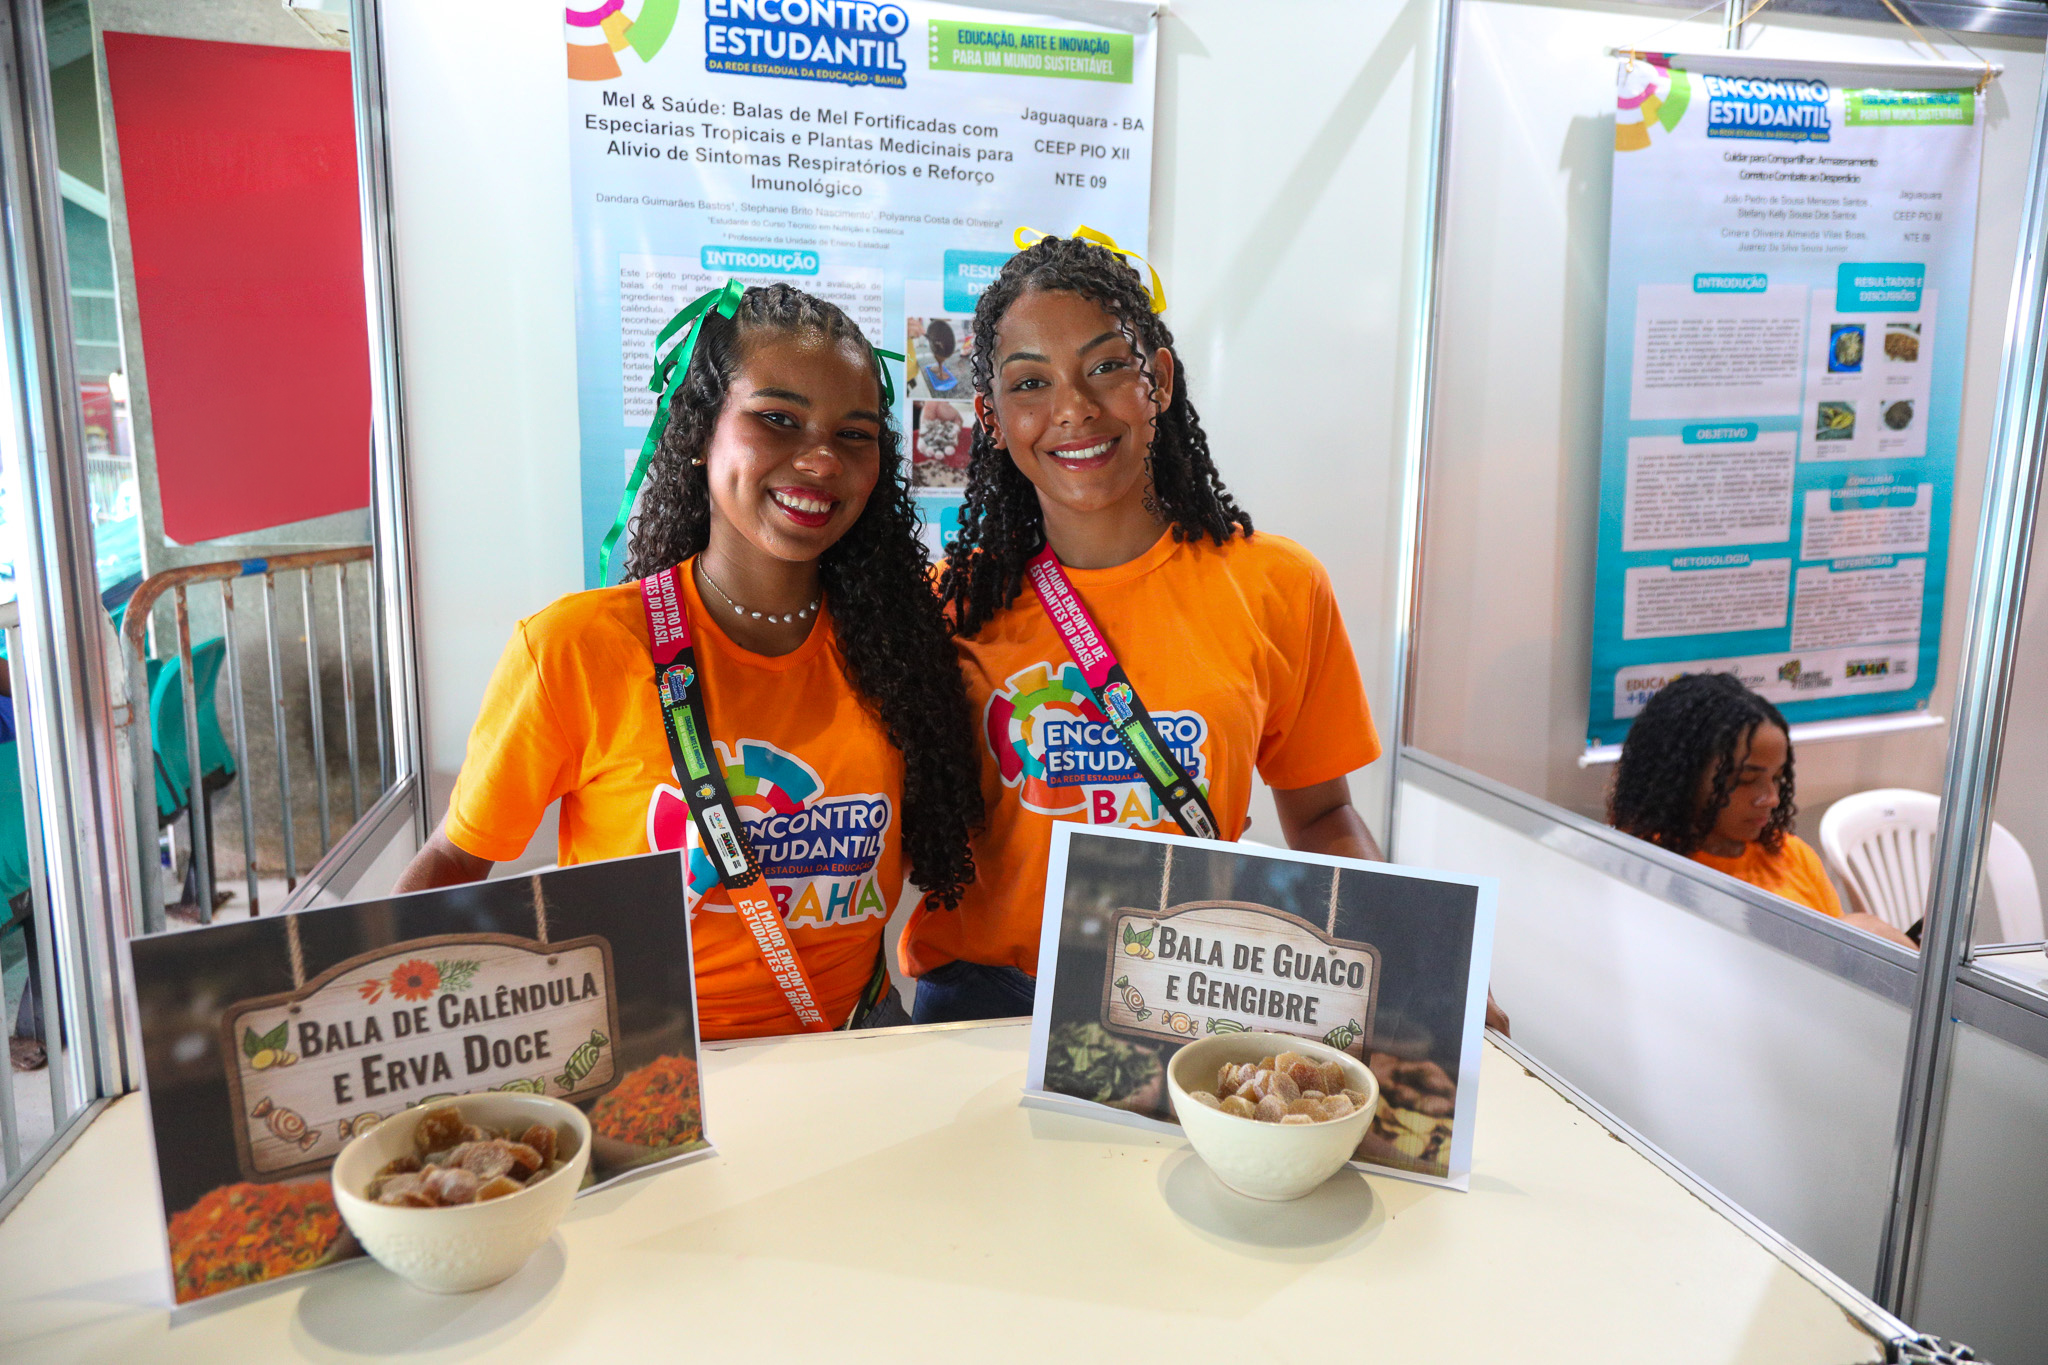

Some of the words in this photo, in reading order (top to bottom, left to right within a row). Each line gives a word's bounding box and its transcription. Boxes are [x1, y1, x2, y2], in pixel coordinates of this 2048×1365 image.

[708, 0, 907, 35] ENCONTRO
[708, 24, 904, 70] ESTUDANTIL
[958, 29, 1018, 49] EDUCAÇÃO,
[1020, 34, 1047, 50] ARTE
[1050, 36, 1057, 50] E
[1059, 36, 1109, 55] INOVAÇÃO
[709, 59, 724, 70] DA
[725, 61, 751, 73] REDE
[752, 63, 799, 77] ESTADUAL
[801, 67, 815, 78] DA
[816, 68, 868, 83] EDUCAÇÃO
[875, 74, 904, 86] BAHIA
[953, 49, 982, 65] PARA
[984, 51, 1001, 66] UM
[1003, 52, 1042, 69] MUNDO
[1044, 54, 1114, 75] SUSTENTÁVEL
[1704, 76, 1829, 102] ENCONTRO
[602, 91, 635, 108] Mel
[642, 95, 655, 110] &
[662, 97, 726, 115] Saúde:
[733, 101, 783, 120] Balas
[790, 107, 811, 122] de
[818, 108, 848, 125] Mel
[854, 111, 957, 135] Fortificadas
[962, 124, 998, 138] com
[1021, 107, 1108, 128] Jaguaquara
[1122, 117, 1144, 131] BA
[1709, 100, 1830, 128] ESTUDANTIL
[585, 114, 695, 138] Especiarias
[701, 123, 785, 144] Tropicais
[791, 134, 801, 145] e
[808, 131, 873, 151] Plantas
[880, 137, 971, 159] Medicinais
[978, 149, 1013, 162] para
[1034, 139, 1076, 155] CEEP
[1080, 144, 1106, 159] PIO
[1111, 146, 1130, 160] XII
[607, 140, 661, 159] Alívio
[667, 146, 689, 161] de
[695, 147, 781, 167] Sintomas
[788, 153, 907, 176] Respiratórios
[912, 166, 922, 177] e
[928, 164, 994, 186] Reforço
[751, 174, 862, 198] Imunológico
[1055, 172, 1085, 187] NTE
[1090, 175, 1107, 189] 09
[596, 193, 639, 205] Dandara
[641, 195, 695, 209] Guimarães
[740, 202, 788, 216] Stephanie
[791, 205, 813, 216] Brito
[879, 211, 921, 224] Polyanna
[924, 213, 951, 225] Costa
[952, 216, 964, 226] de
[620, 268, 640, 278] Este
[646, 271, 677, 281] projeto
[706, 250, 816, 273] INTRODUÇÃO
[1697, 275, 1766, 290] INTRODUÇÃO
[1696, 427, 1748, 440] OBJETIVO
[1042, 560, 1053, 569] O
[1673, 553, 1750, 568] METODOLOGIA
[1030, 563, 1068, 622] ESTUDANTES
[1045, 566, 1069, 597] MAIOR
[648, 596, 663, 610] DO
[660, 576, 681, 626] ENCONTRO
[651, 611, 670, 647] BRASIL
[669, 626, 684, 641] DE
[1061, 594, 1099, 647] ENCONTRO
[1061, 620, 1076, 636] DO
[1068, 636, 1096, 672] BRASIL
[1090, 645, 1108, 662] DE
[1050, 776, 1062, 784] DA
[1063, 773, 1085, 783] REDE
[1087, 772, 1132, 782] ESTADUAL
[748, 803, 886, 843] NCONTRO
[754, 835, 879, 864] TUDANTIL
[765, 866, 813, 875] ESTADUAL
[816, 864, 829, 873] DA
[831, 861, 873, 875] EDUCAÇÃO
[754, 899, 769, 910] O
[769, 875, 884, 922] BAHIA
[758, 910, 786, 948] MAIOR
[738, 899, 784, 973] ESTUDANTES
[775, 974, 792, 989] DO
[784, 991, 811, 1027] BRASIL
[1158, 926, 1223, 968] BALA
[1232, 943, 1265, 974] DE
[1273, 944, 1365, 990] GUACO
[777, 948, 815, 1007] ENCONTRO
[1166, 974, 1179, 1001] E
[1187, 973, 1319, 1025] GENGIBRE
[299, 1013, 382, 1060] BALA
[393, 1004, 430, 1037] DE
[437, 972, 598, 1030] CALÊNDULA
[807, 1009, 824, 1024] DE
[333, 1070, 352, 1104] E
[362, 1053, 453, 1100] ERVA
[463, 1029, 551, 1075] DOCE
